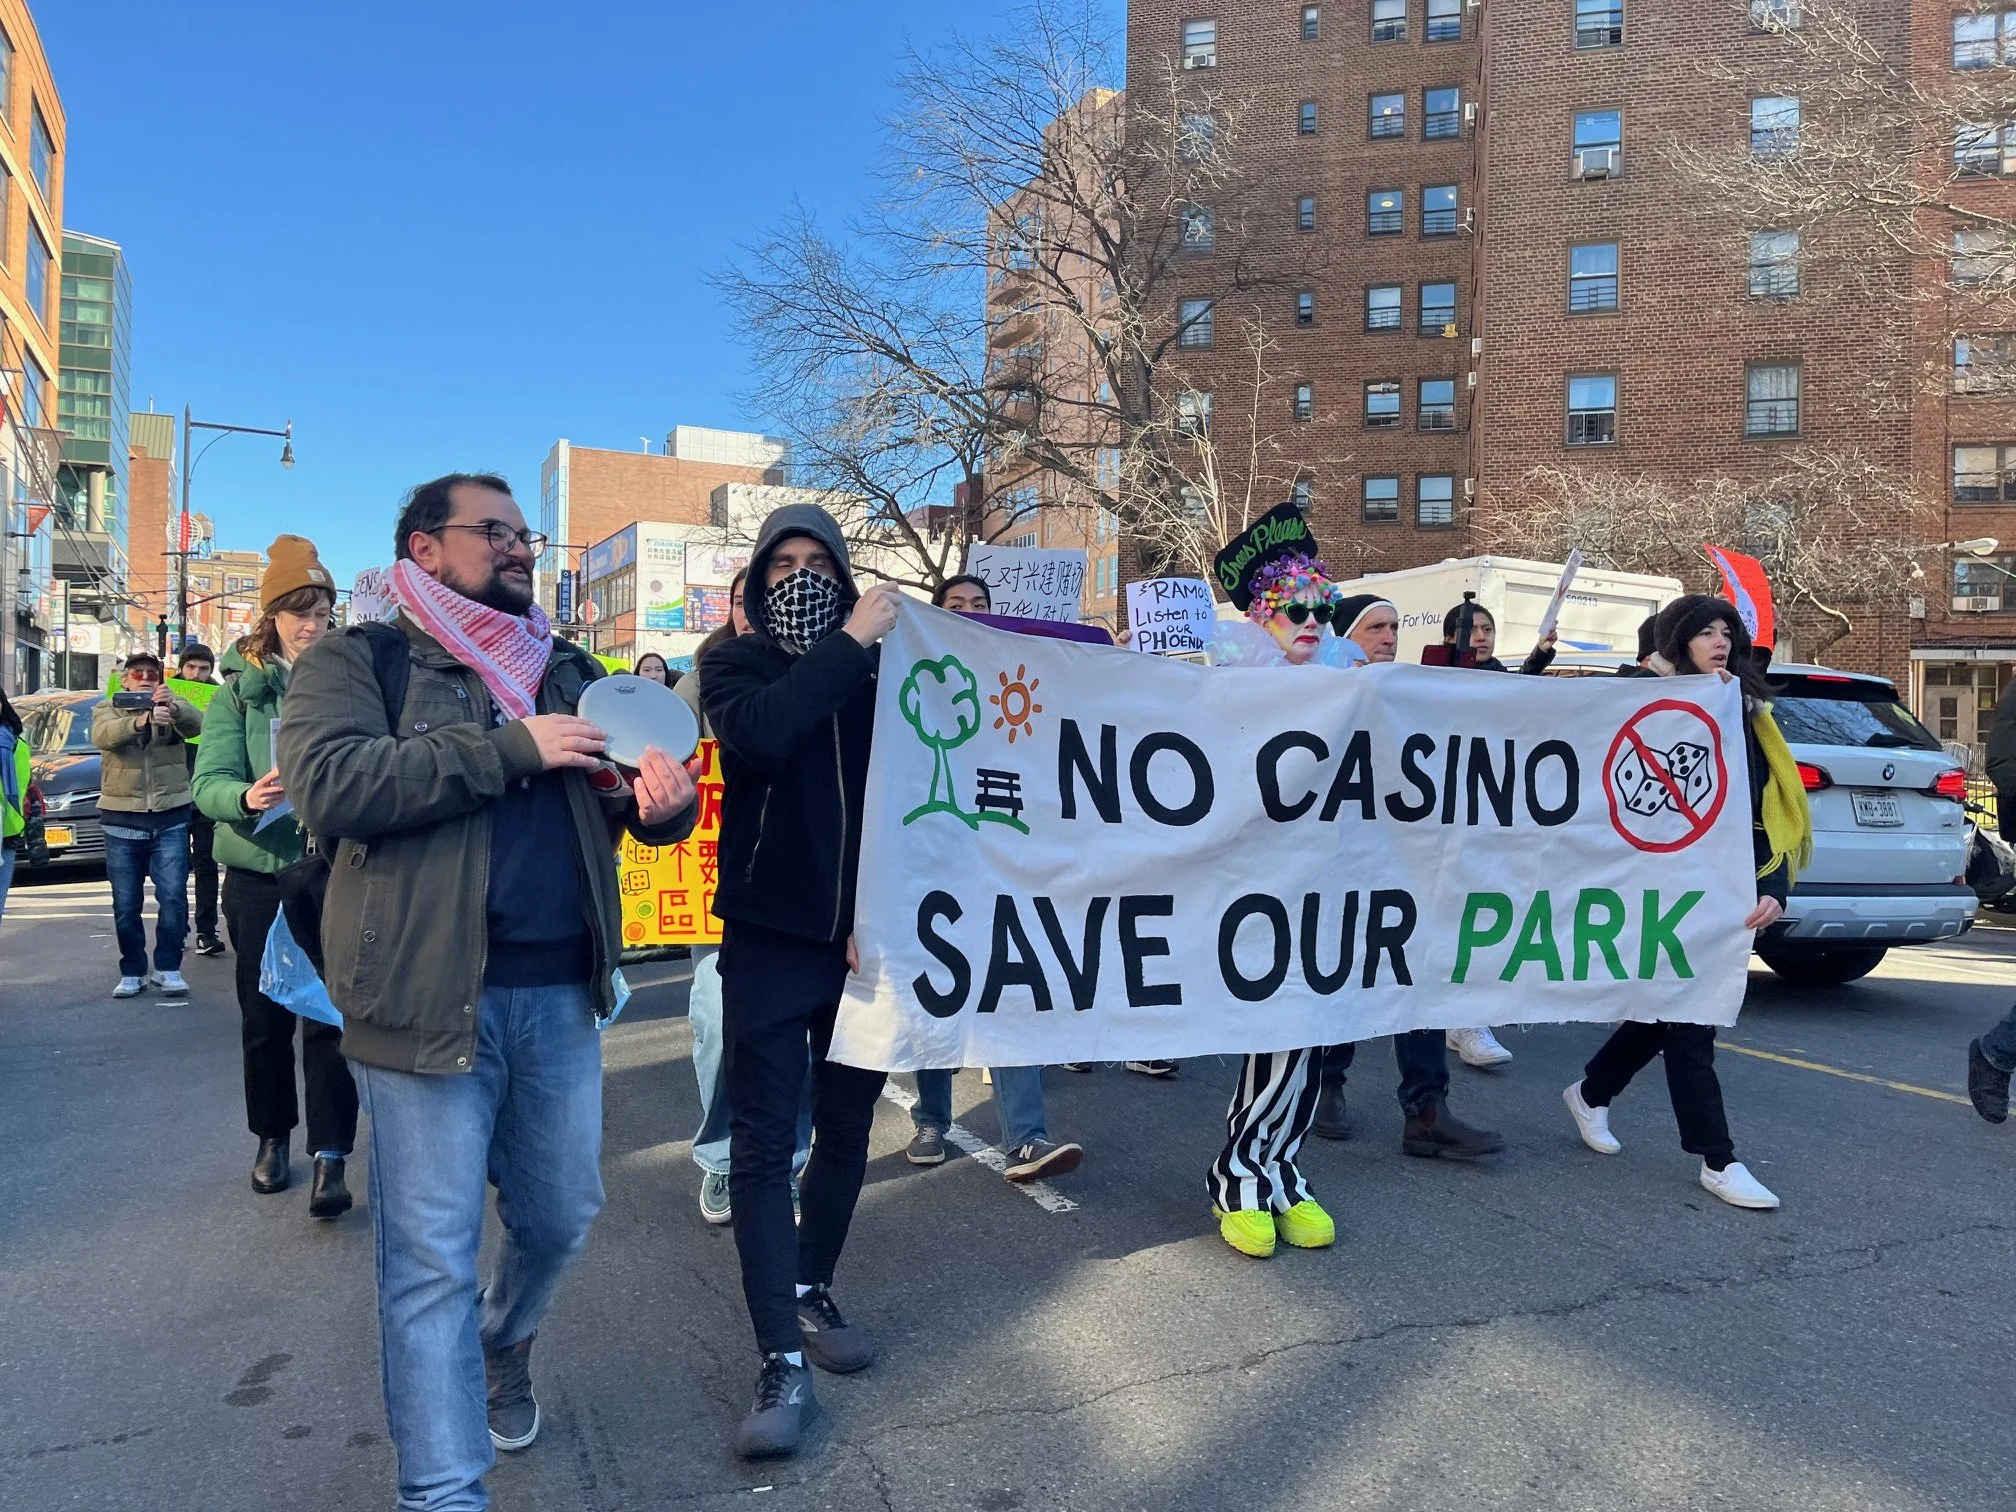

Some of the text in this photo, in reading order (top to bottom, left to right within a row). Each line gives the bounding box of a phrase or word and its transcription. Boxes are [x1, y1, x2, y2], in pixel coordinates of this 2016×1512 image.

[1565, 594, 1598, 608] 500213
[1195, 608, 1207, 620] to
[1402, 612, 1441, 628] For You.
[1167, 624, 1192, 634] OUR
[1058, 718, 1580, 827] NO CASINO
[912, 888, 1705, 1018] SAVE OUR PARK
